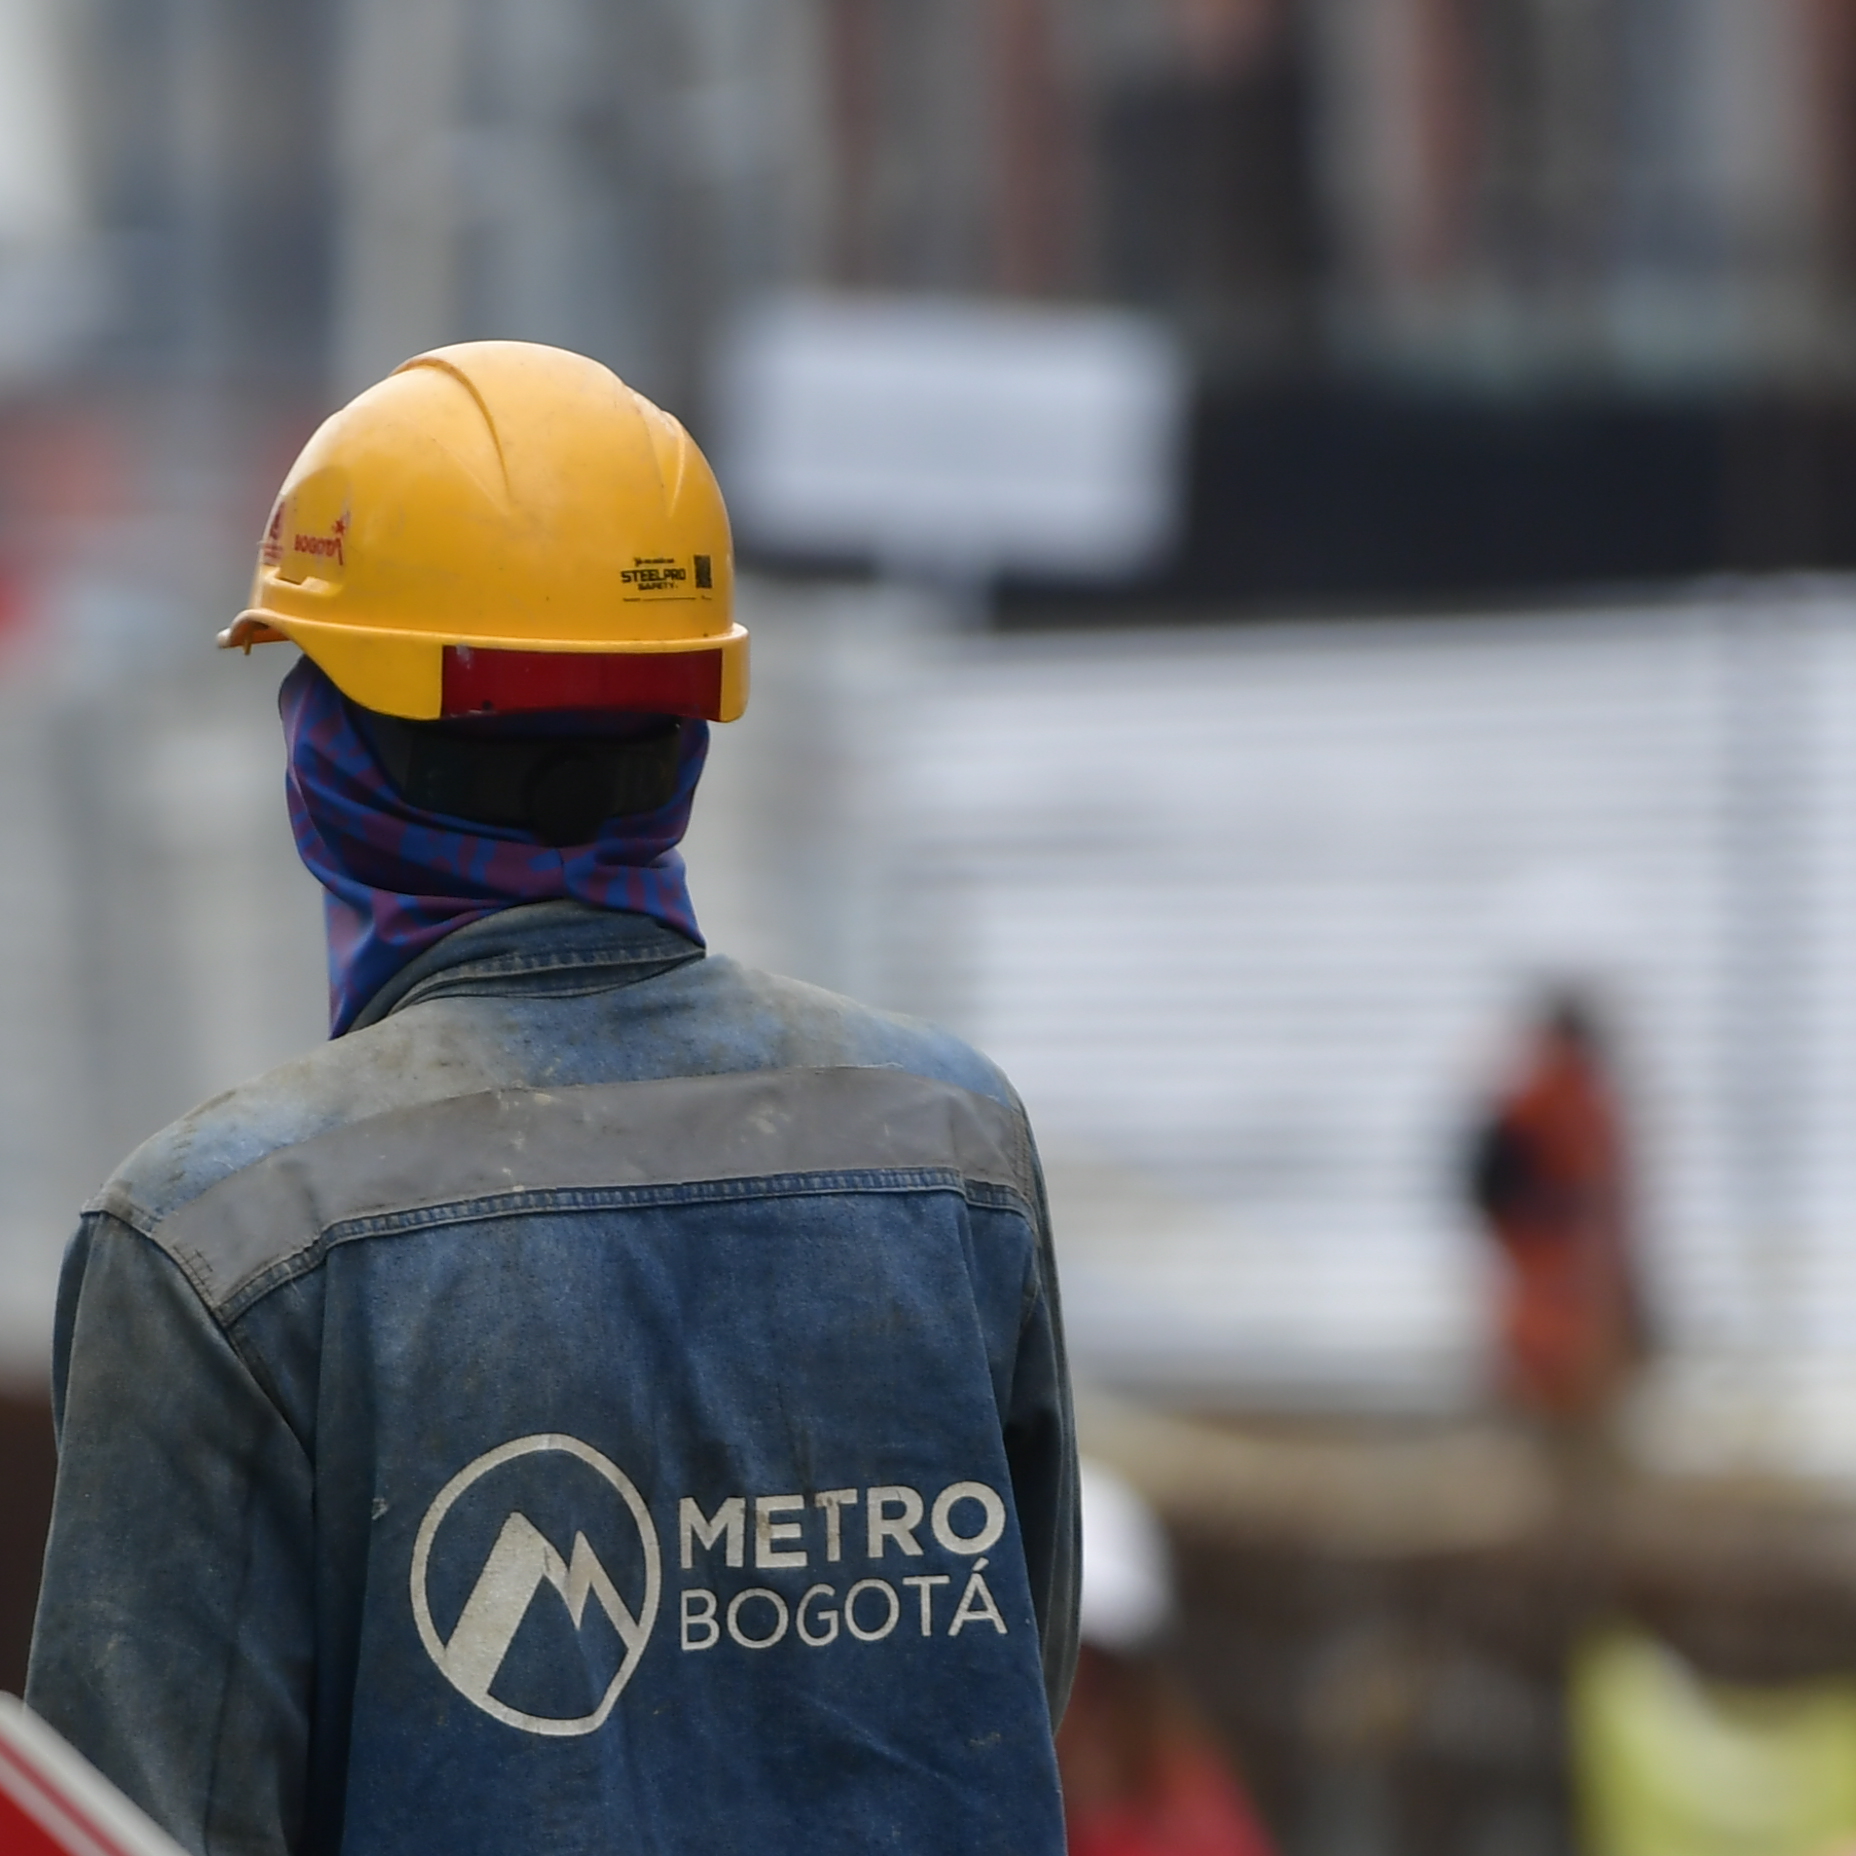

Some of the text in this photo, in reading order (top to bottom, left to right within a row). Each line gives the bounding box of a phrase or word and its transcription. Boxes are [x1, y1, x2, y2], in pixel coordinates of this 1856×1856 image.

[621, 568, 686, 583] STEELPRO
[680, 1480, 1005, 1569] METRO
[681, 1558, 1008, 1652] BOGOTÁ
